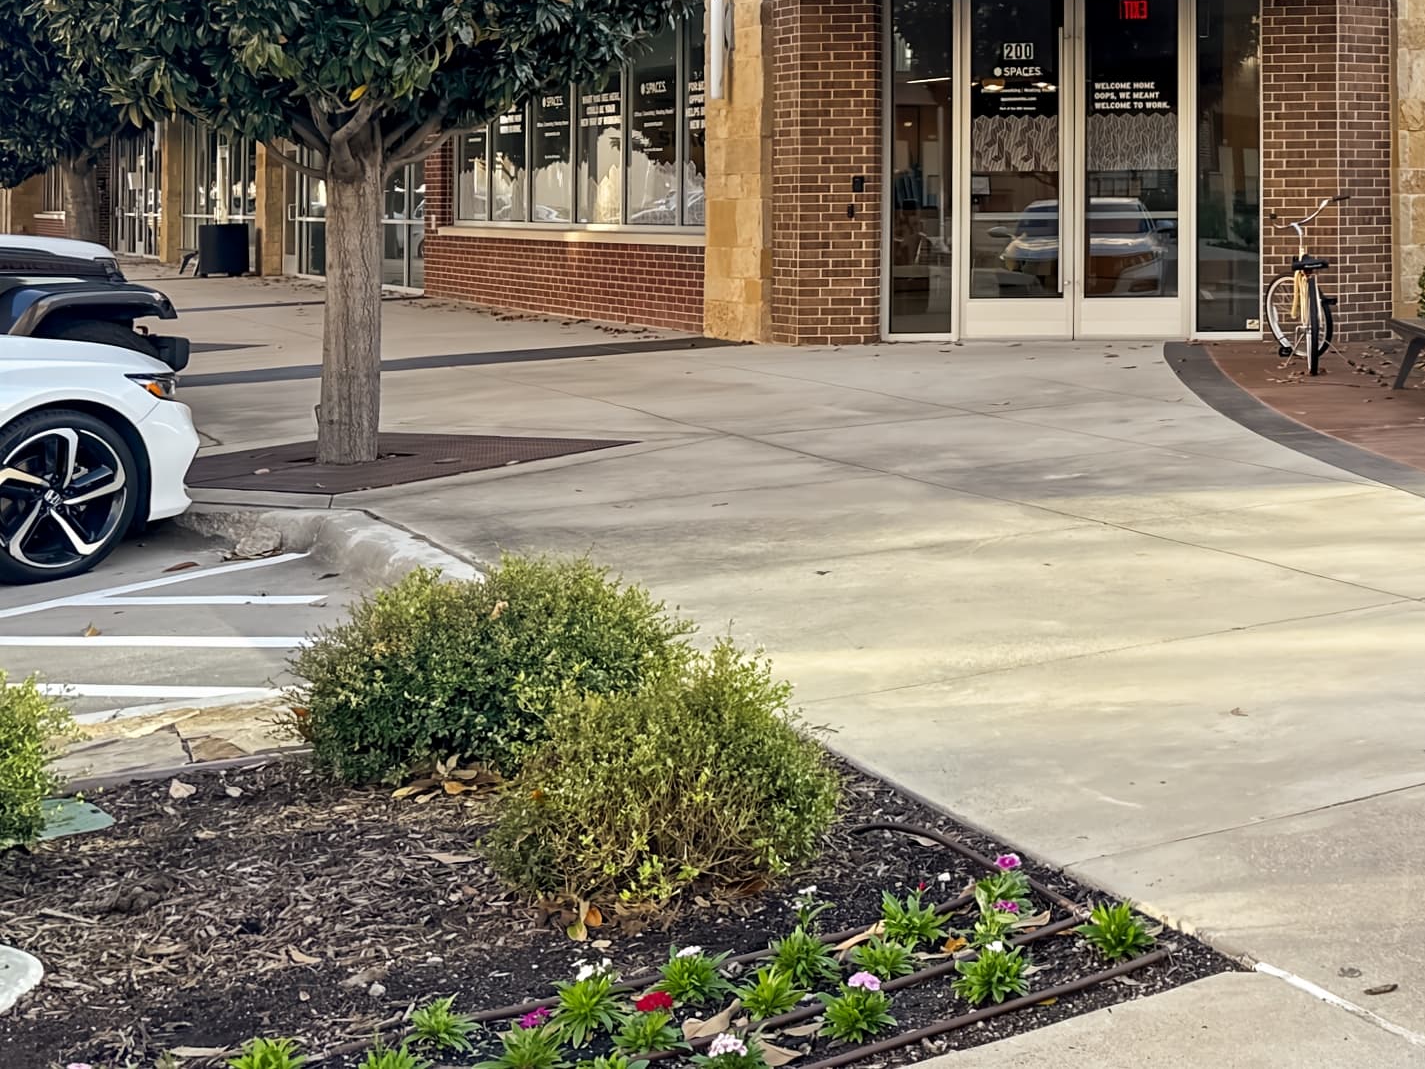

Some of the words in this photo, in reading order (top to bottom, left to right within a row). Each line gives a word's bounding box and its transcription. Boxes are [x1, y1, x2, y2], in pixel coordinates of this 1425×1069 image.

[1005, 44, 1032, 59] 200
[1094, 82, 1132, 90] WELCOME
[1094, 92, 1117, 100] OOPS,
[1133, 91, 1160, 99] MEANT
[1133, 101, 1144, 109] TO
[1145, 101, 1171, 109] WORK.
